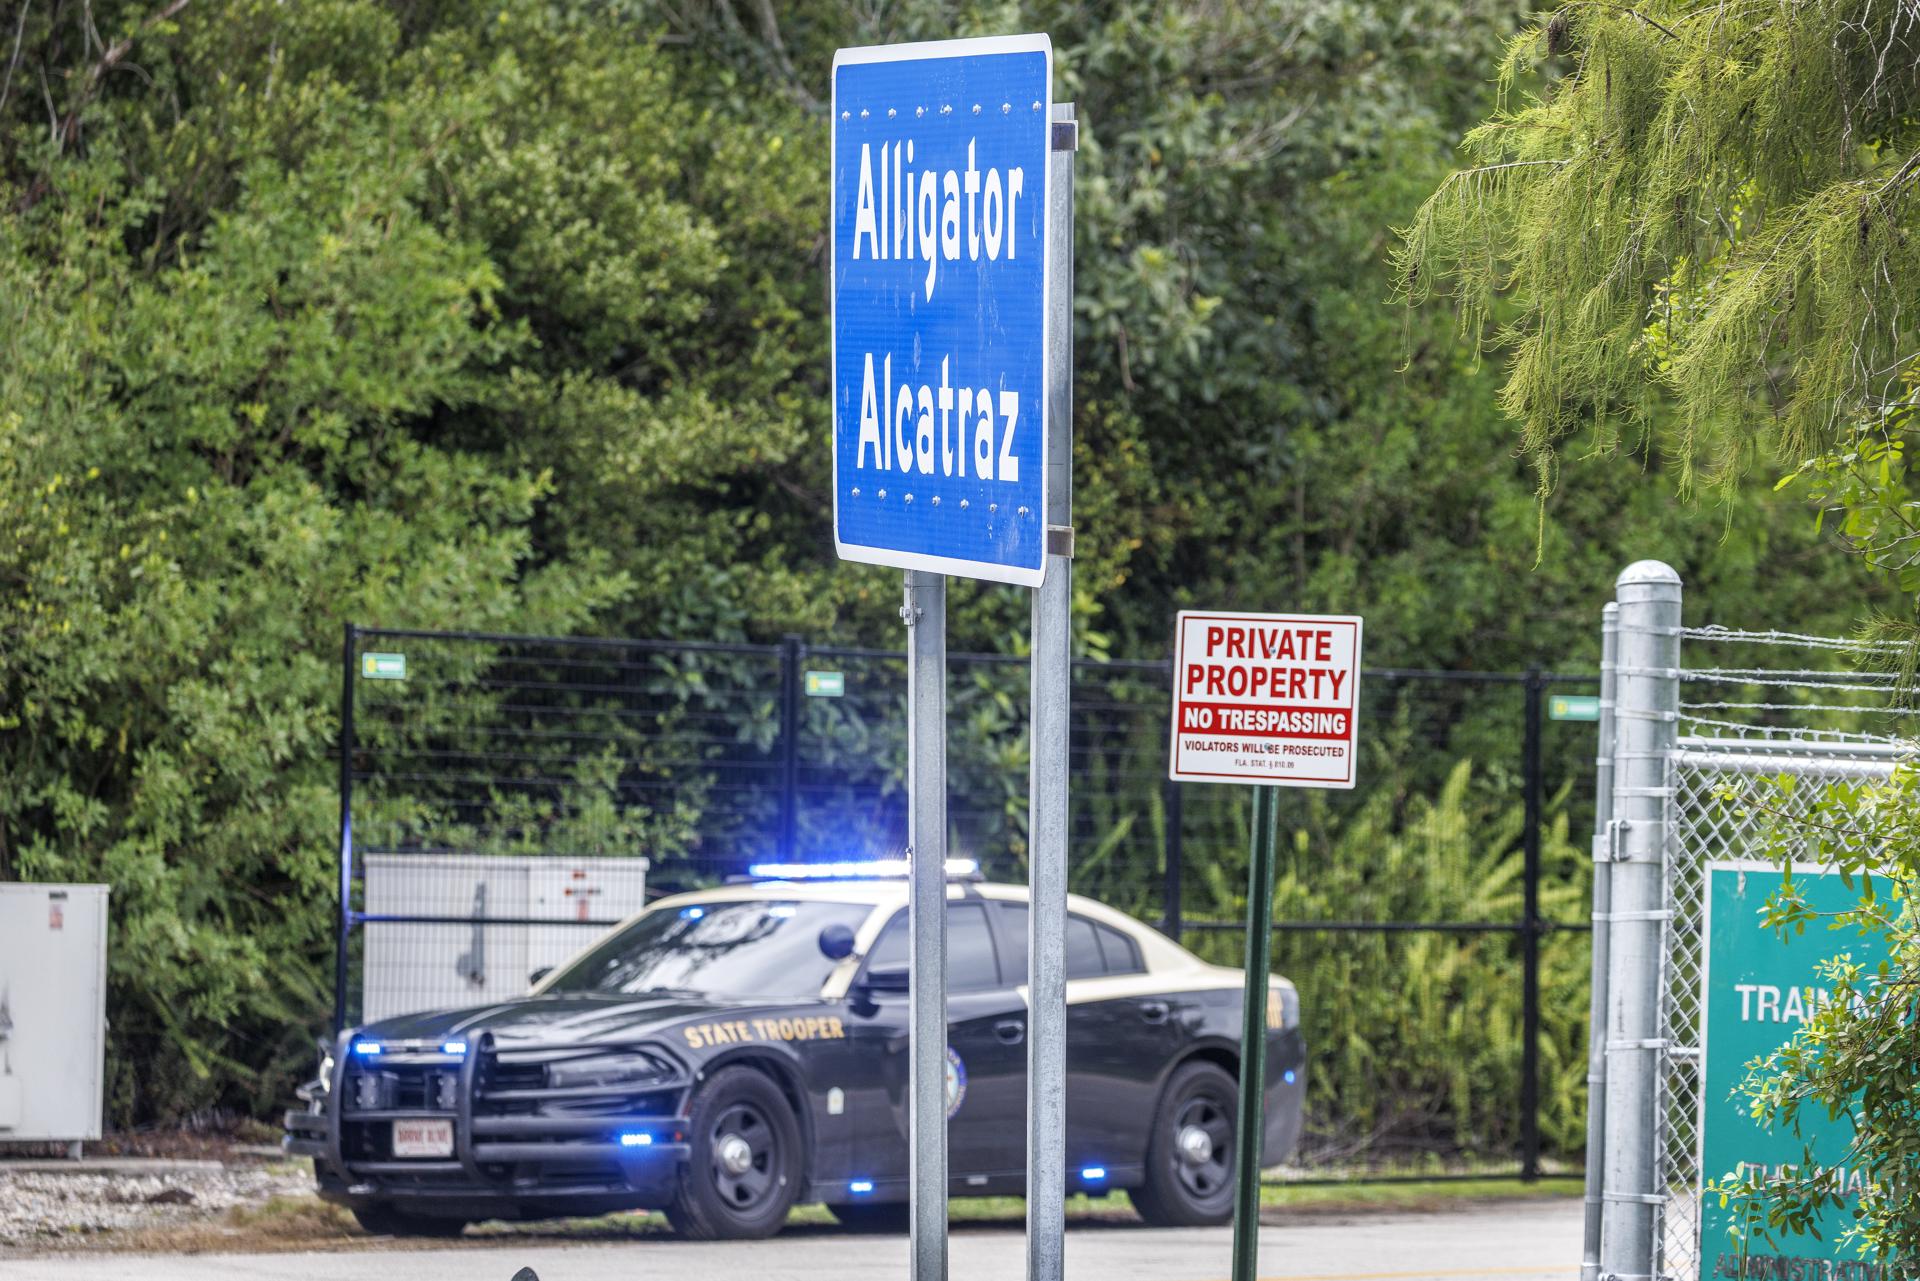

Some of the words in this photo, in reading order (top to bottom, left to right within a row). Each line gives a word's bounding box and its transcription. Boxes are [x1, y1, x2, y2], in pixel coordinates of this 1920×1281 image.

[853, 136, 1024, 303] Alligator
[857, 352, 1019, 482] Alcatraz
[1206, 626, 1332, 662] PRIVATE
[1187, 664, 1347, 700] PROPERTY
[1184, 707, 1213, 729] NO
[1218, 709, 1346, 735] TRESPASSING
[1184, 740, 1239, 752] VIOLATORS
[1242, 743, 1265, 754] WILL
[1268, 744, 1280, 754] BE
[1283, 745, 1344, 757] PROSECUTED
[684, 1020, 753, 1049] STATE
[752, 1015, 845, 1041] TROOPER
